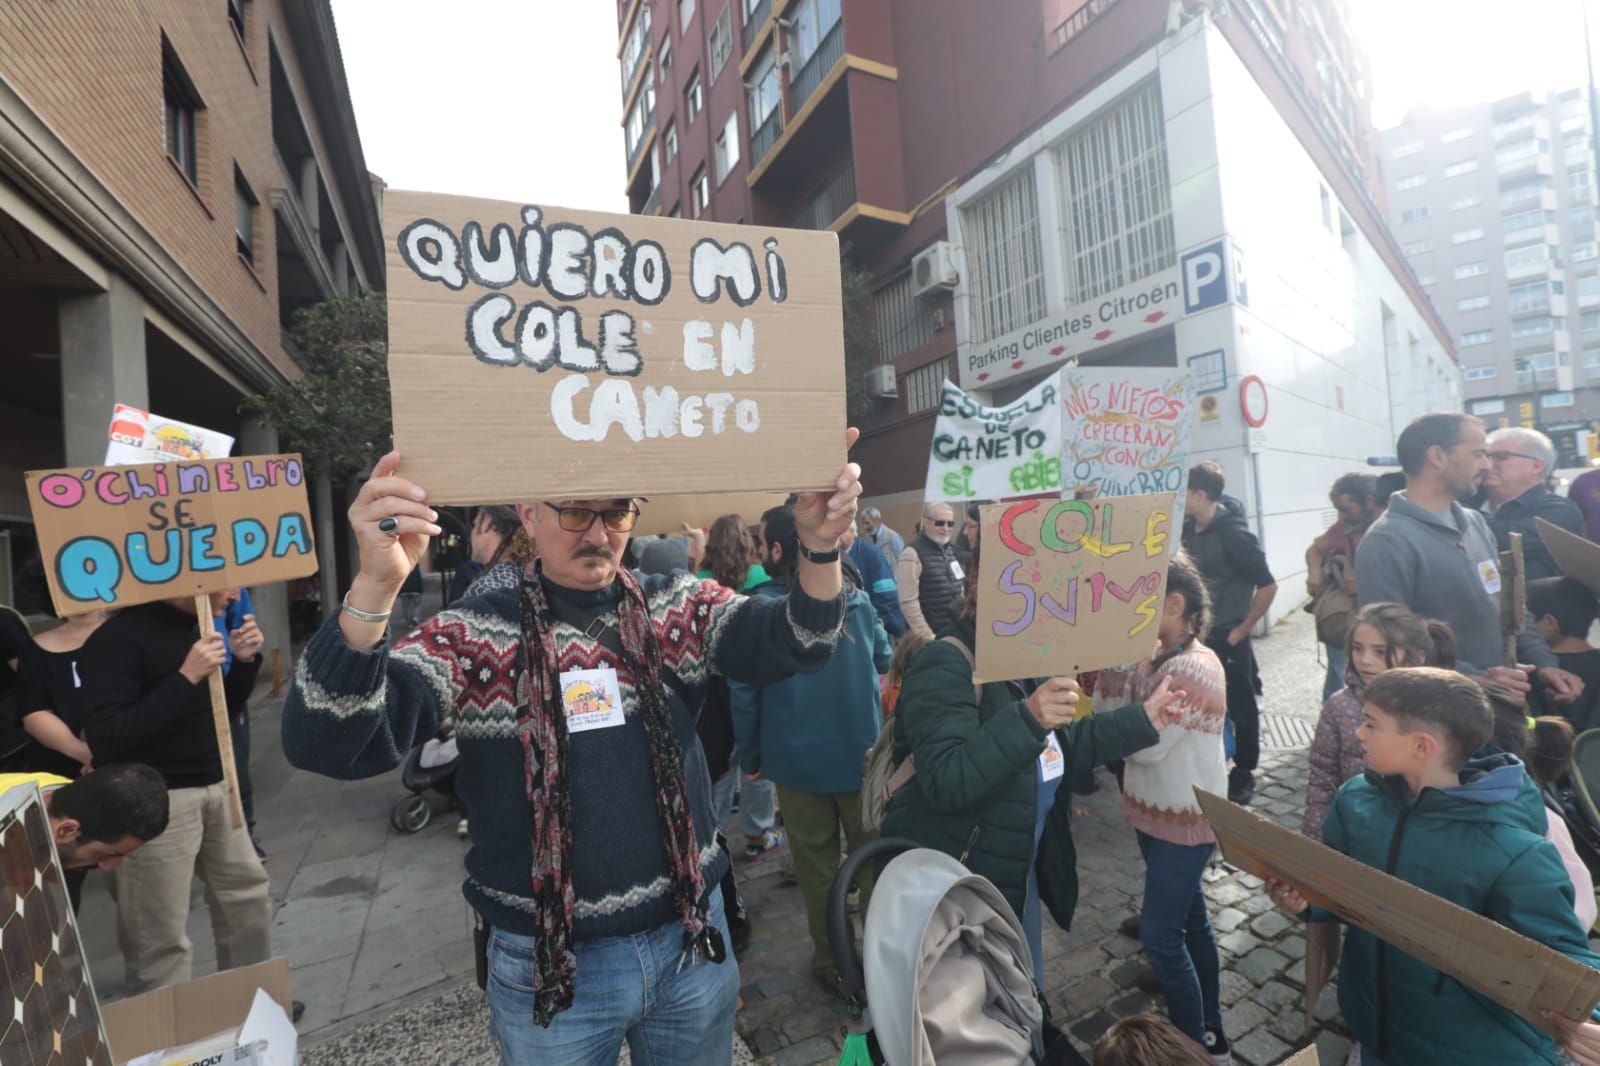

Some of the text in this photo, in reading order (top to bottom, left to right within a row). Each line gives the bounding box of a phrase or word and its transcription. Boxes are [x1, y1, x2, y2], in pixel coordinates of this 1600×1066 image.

[1186, 252, 1221, 306] P
[465, 293, 756, 376] COLE EN
[968, 281, 1179, 371] Parking Clientes Citroën
[550, 373, 761, 442] CANETO
[1083, 422, 1173, 448] CRECERAN
[932, 426, 1046, 462] CANETO
[148, 499, 196, 531] SE
[999, 499, 1169, 558] COLE
[55, 512, 312, 602] QUEDA
